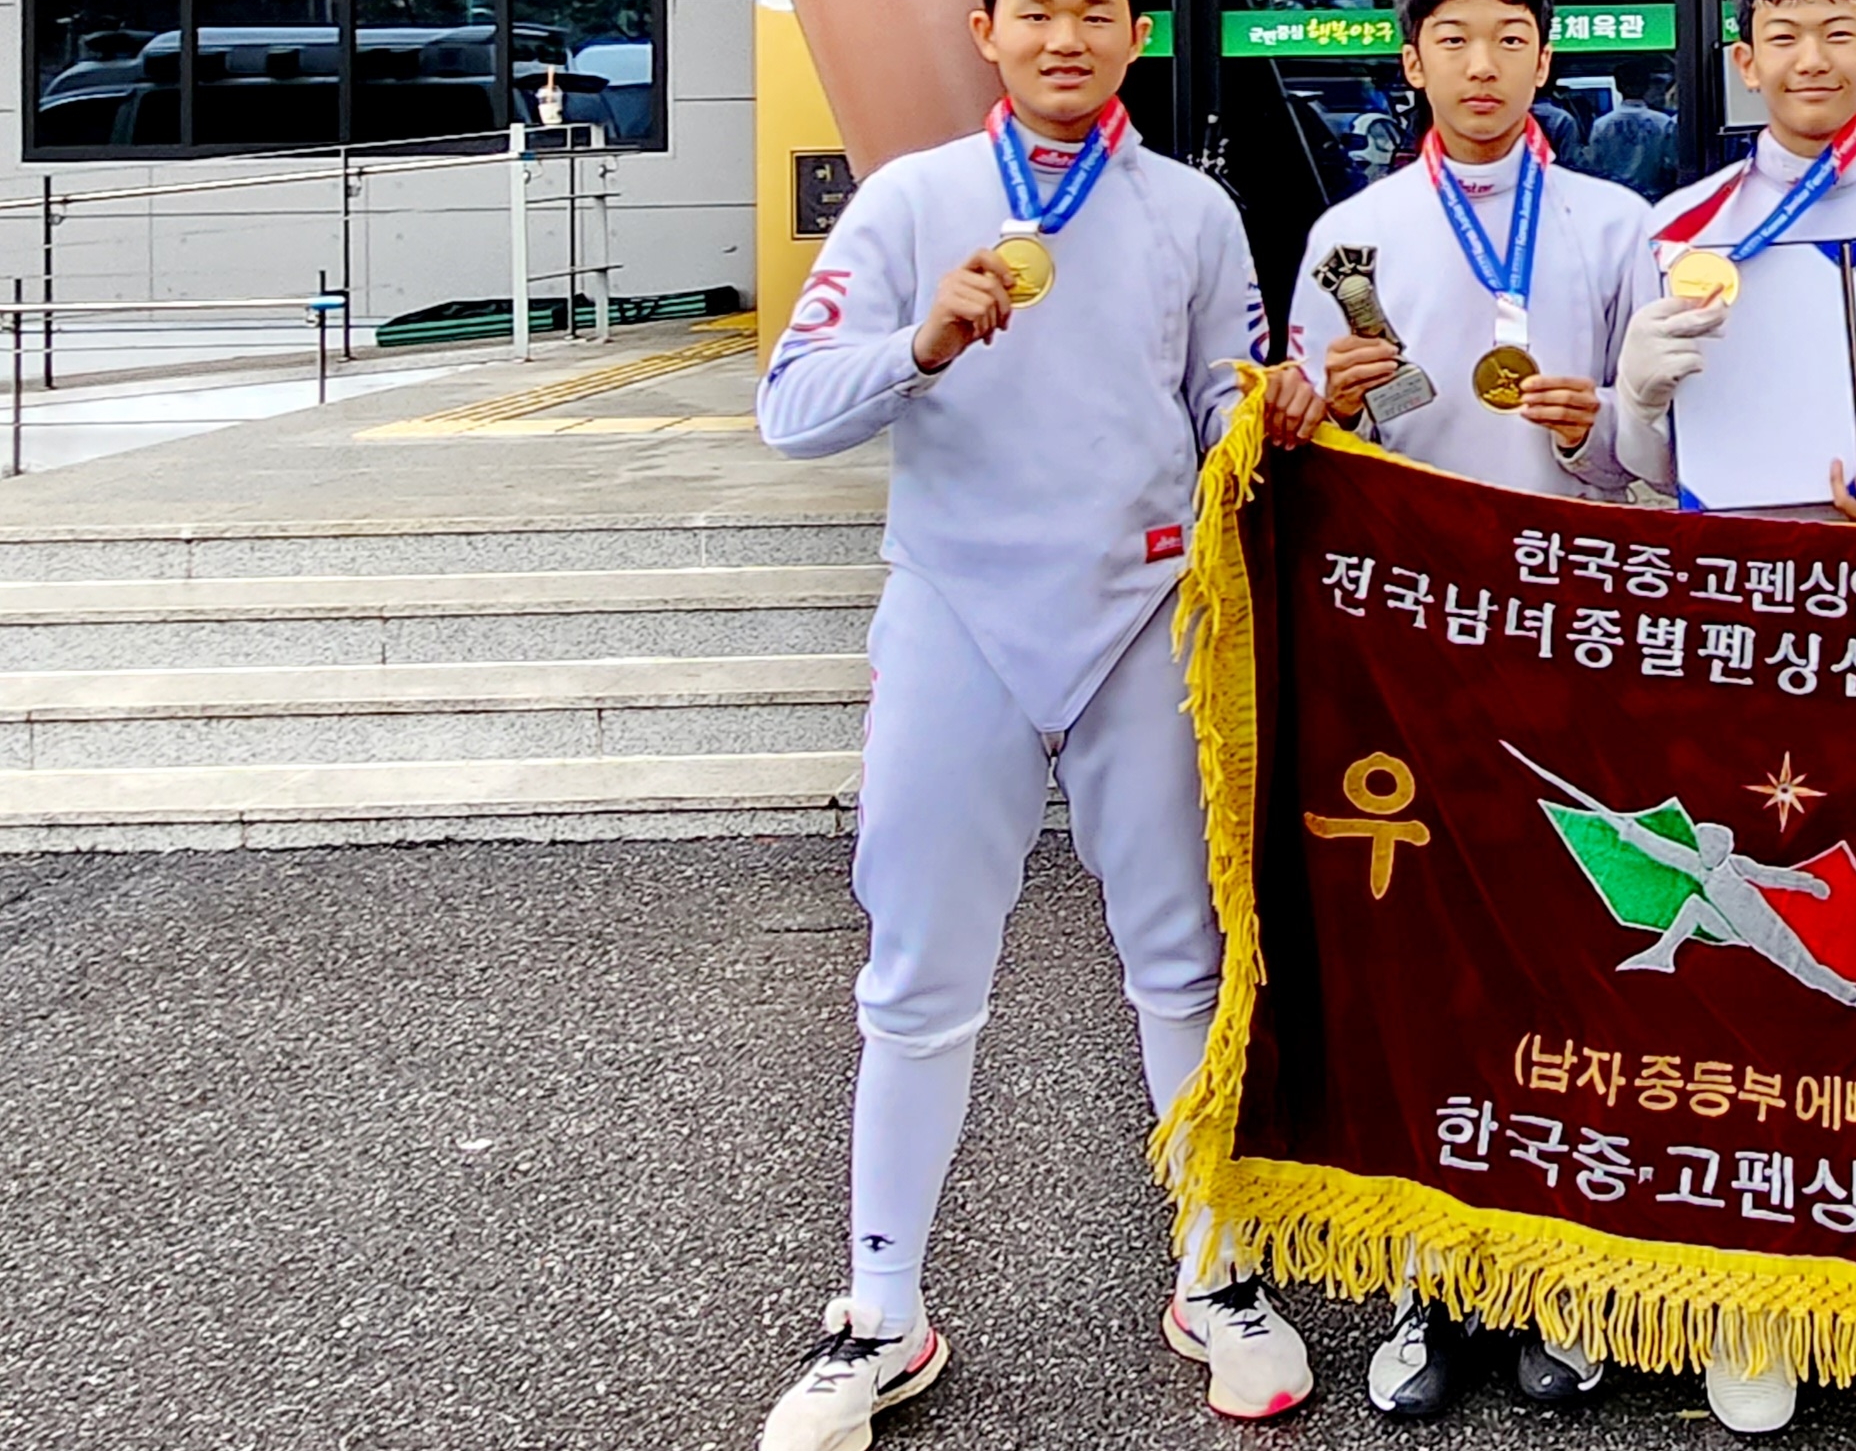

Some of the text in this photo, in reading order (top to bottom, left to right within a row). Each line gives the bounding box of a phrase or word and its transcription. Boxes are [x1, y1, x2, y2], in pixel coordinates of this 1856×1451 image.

[1303, 750, 1432, 901] 우
[1513, 1031, 1627, 1108] (남자
[1633, 1053, 1787, 1123] 중등부
